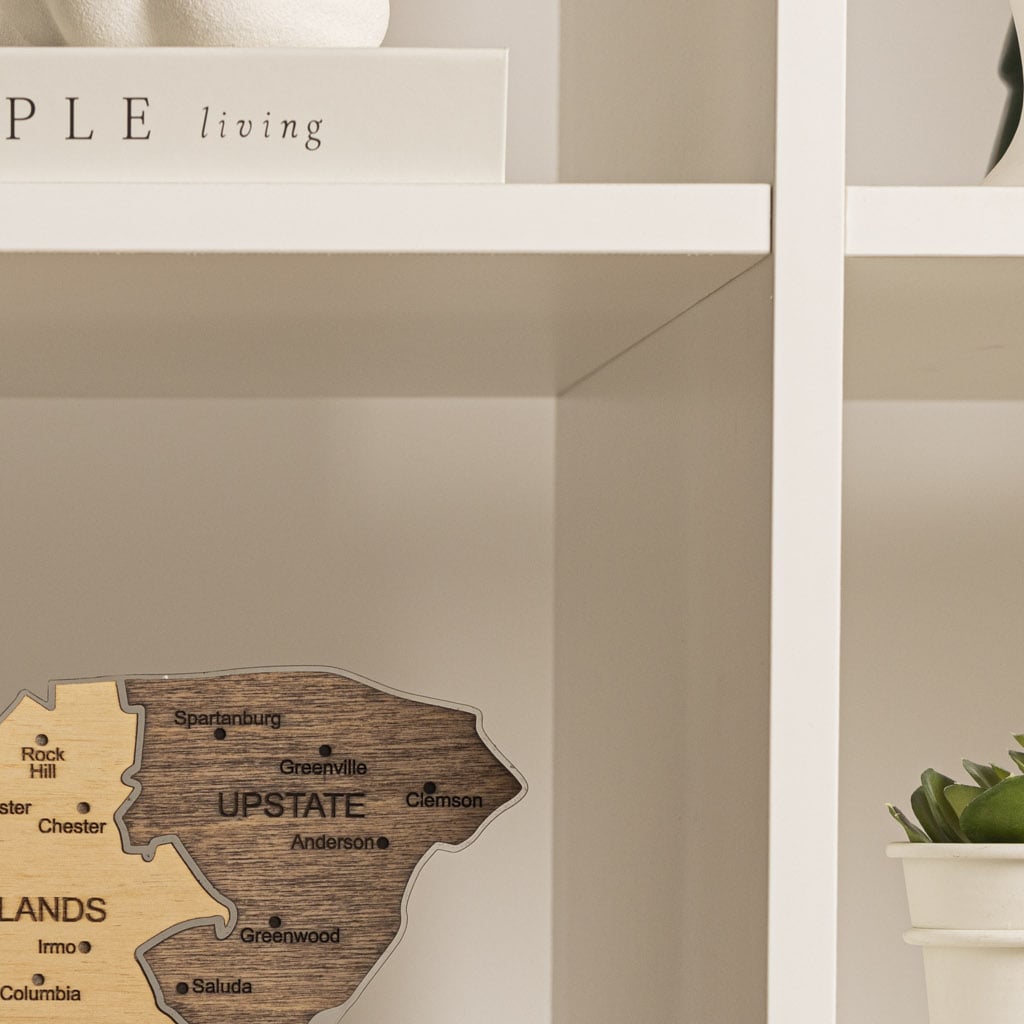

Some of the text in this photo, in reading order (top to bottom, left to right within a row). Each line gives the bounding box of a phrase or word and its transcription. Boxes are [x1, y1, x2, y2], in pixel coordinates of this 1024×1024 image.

[199, 106, 325, 150] living
[174, 711, 281, 729] Spartanburg
[21, 747, 65, 762] Rock
[29, 764, 57, 779] Hill
[280, 759, 367, 776] Greenville
[217, 792, 366, 819] UPSTATE
[406, 792, 483, 809] Clemson
[38, 818, 107, 834] Chester
[290, 833, 375, 850] Anderson
[240, 927, 340, 944] Greenwood
[37, 939, 77, 954] Irmo
[0, 985, 81, 1002] Columbia
[192, 978, 252, 995] Saluda
